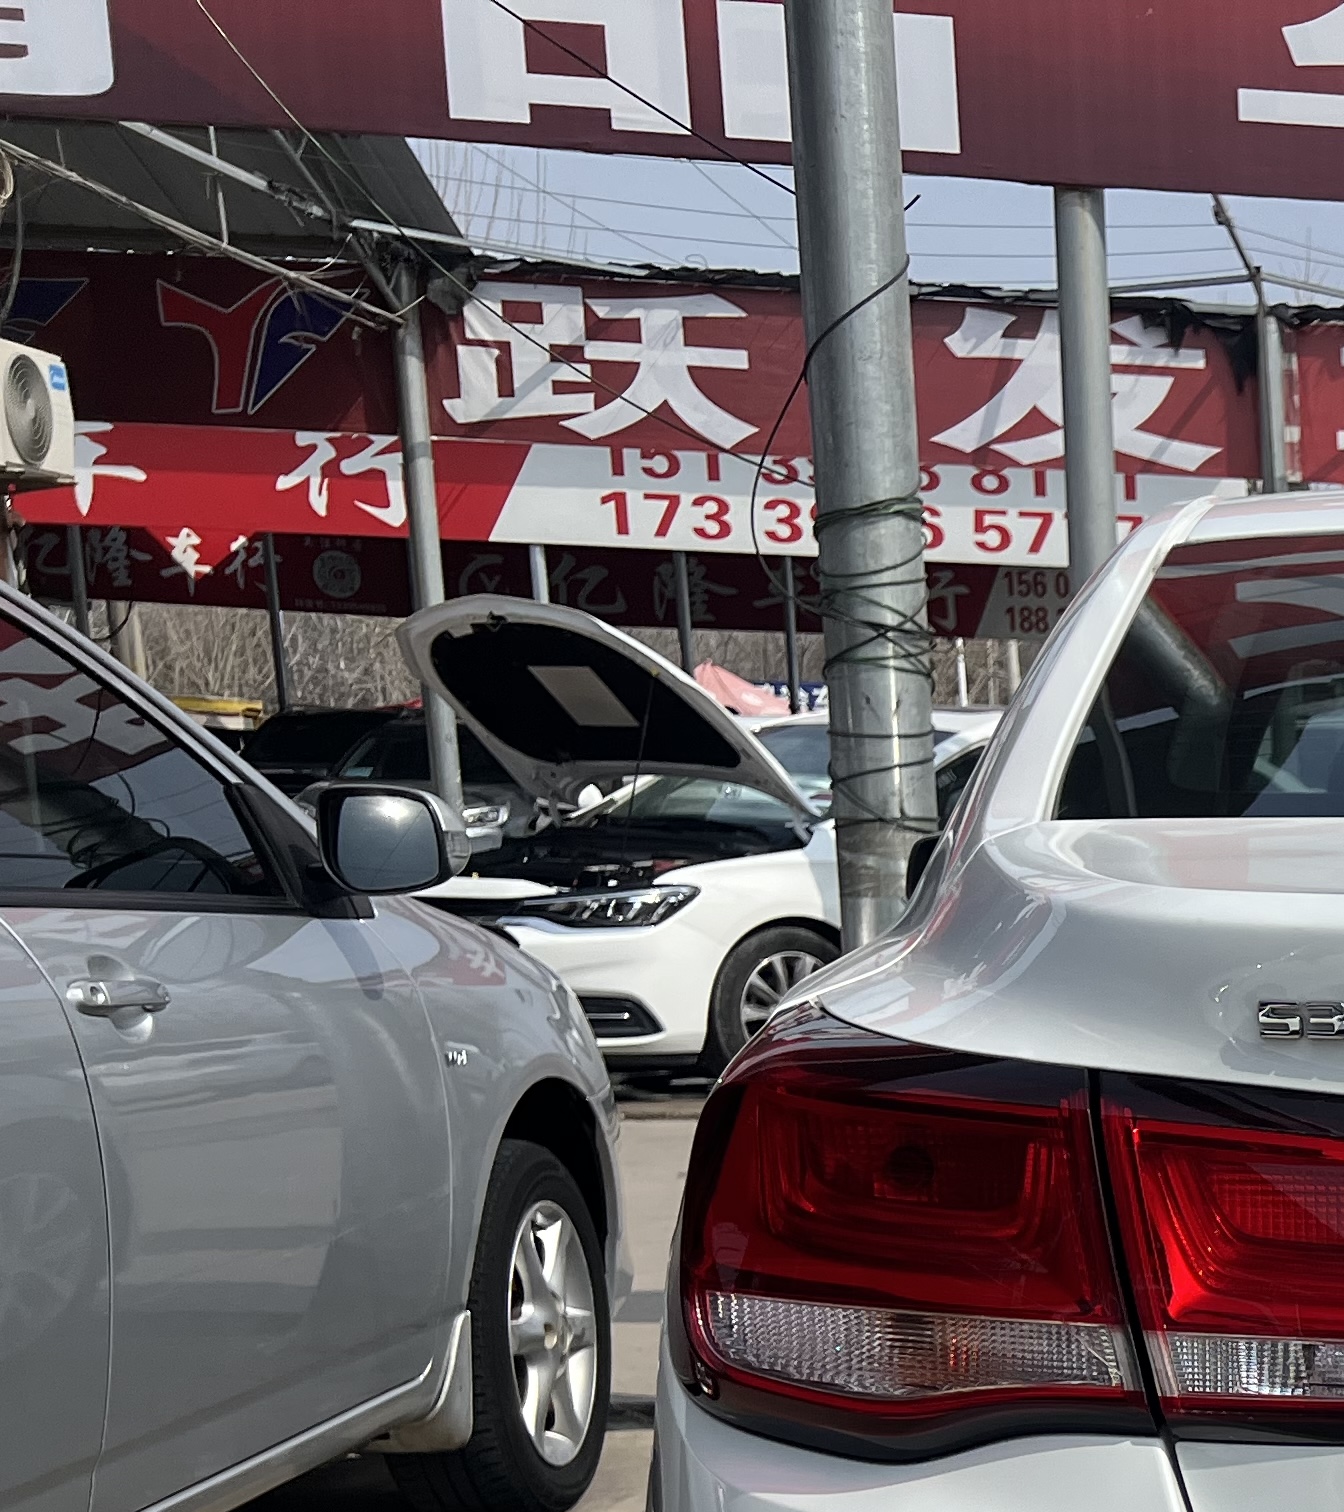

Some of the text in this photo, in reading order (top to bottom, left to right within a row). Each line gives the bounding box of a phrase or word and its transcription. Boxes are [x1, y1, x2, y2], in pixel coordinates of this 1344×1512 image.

[599, 490, 733, 541] 173
[763, 497, 945, 552] 36
[1003, 570, 1047, 598] 156
[1005, 605, 1050, 634] 188
